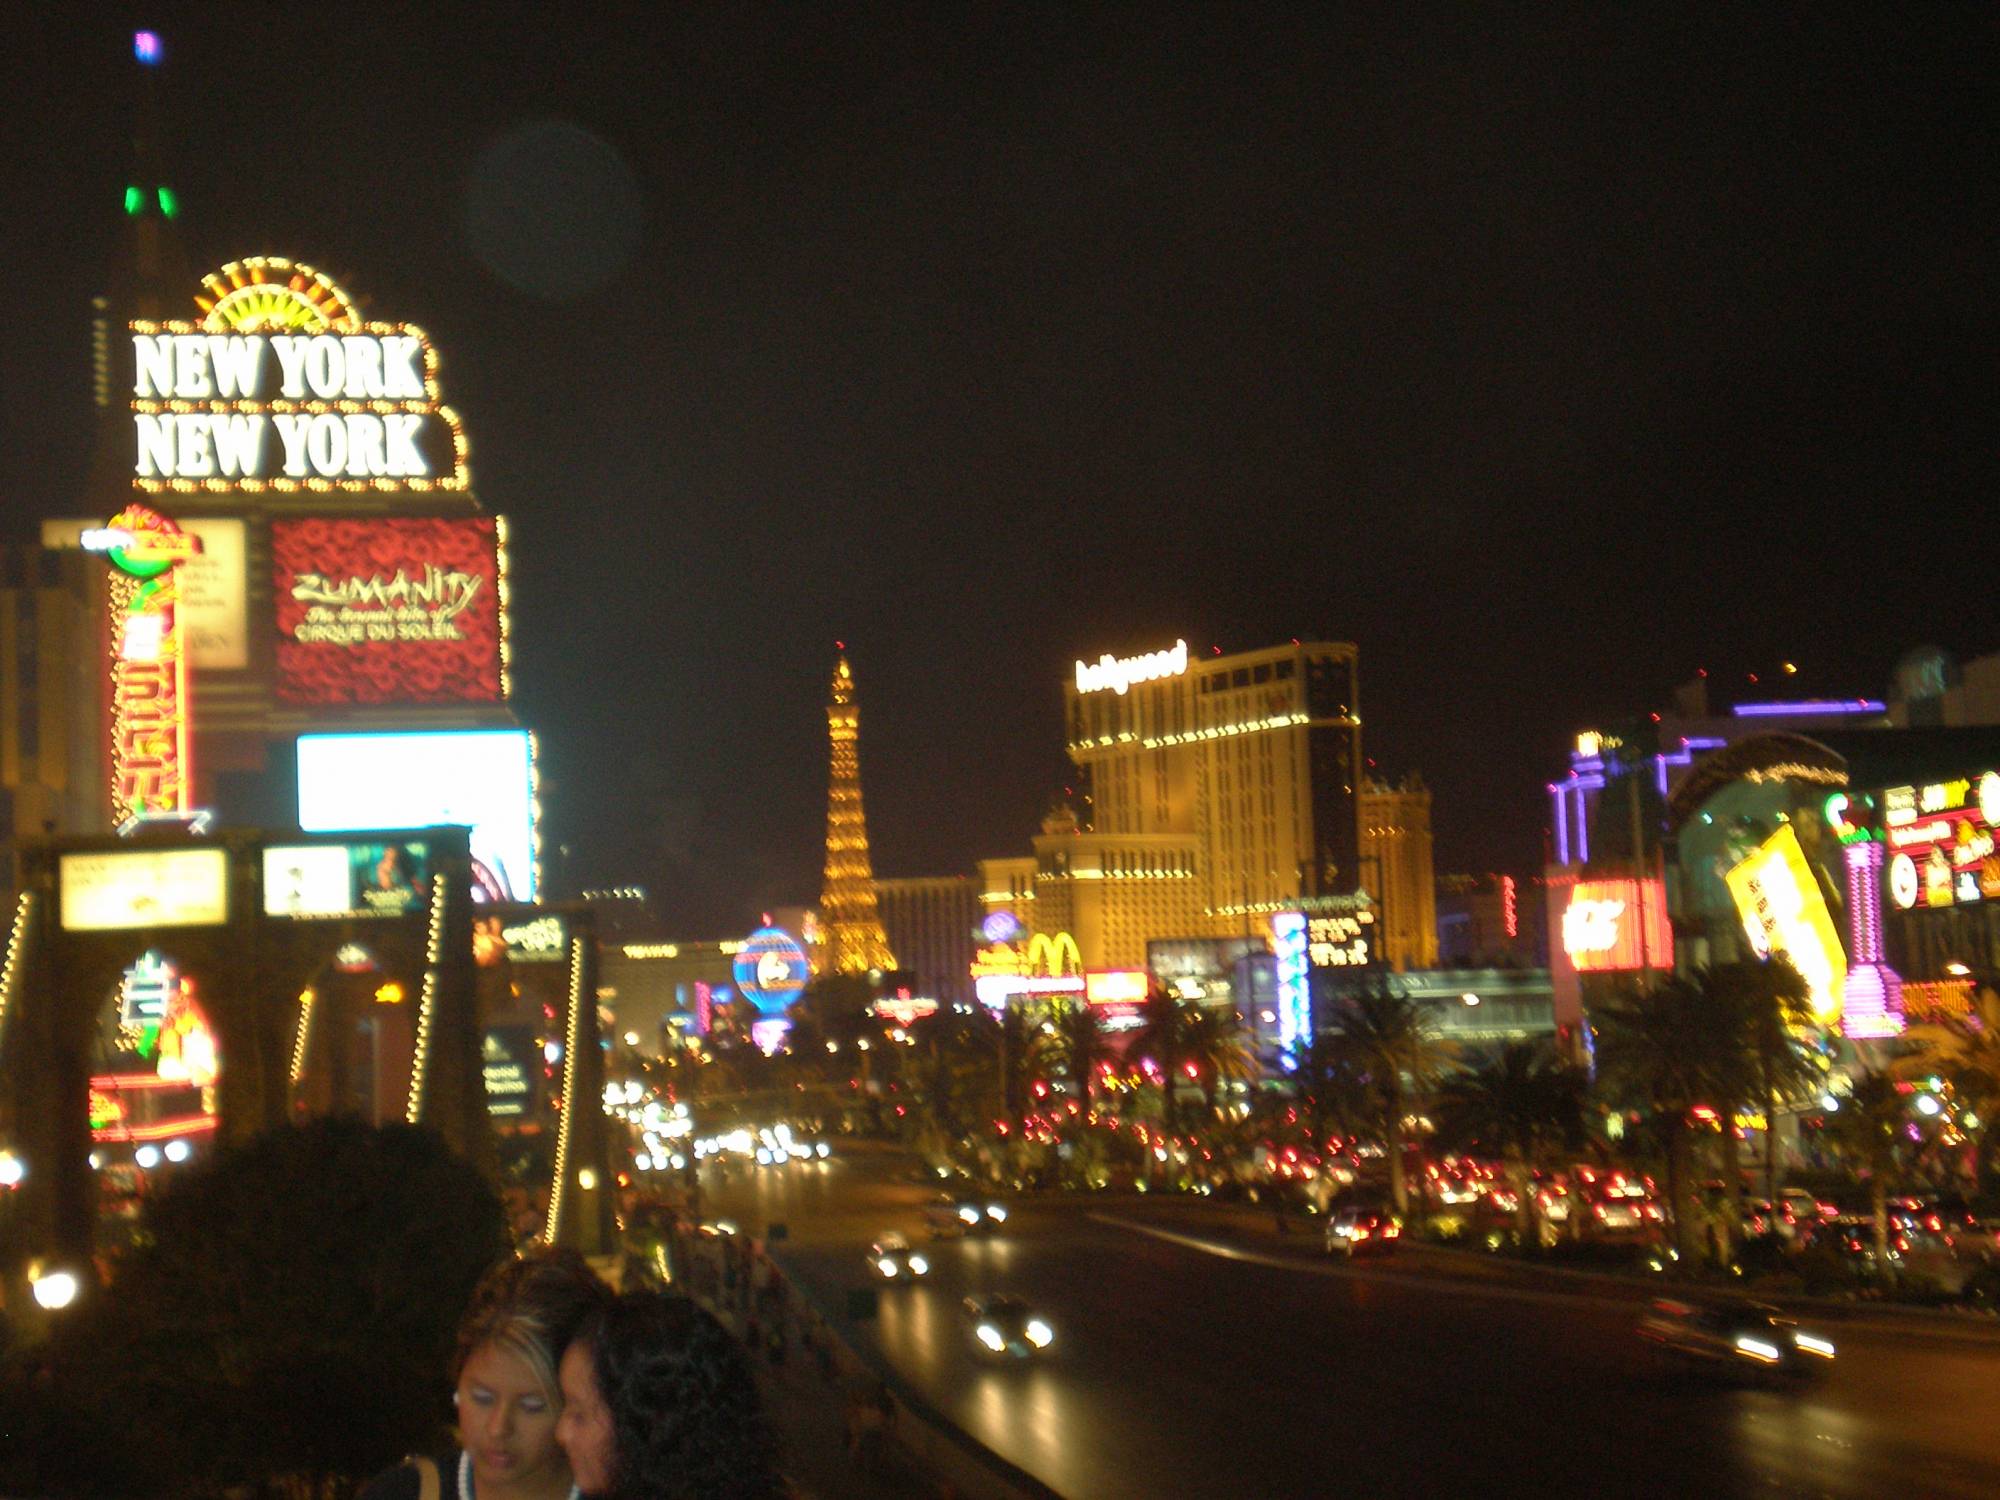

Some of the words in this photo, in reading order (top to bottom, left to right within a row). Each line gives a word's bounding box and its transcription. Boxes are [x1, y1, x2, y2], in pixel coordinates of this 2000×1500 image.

[132, 335, 264, 398] NEW
[269, 335, 425, 398] YORK
[134, 413, 266, 477] NEW
[271, 413, 428, 477] YORK
[291, 562, 482, 620] ZUMANITY
[295, 624, 365, 645] CIRQUE
[367, 623, 396, 641] DU
[397, 623, 466, 641] SOLEIL
